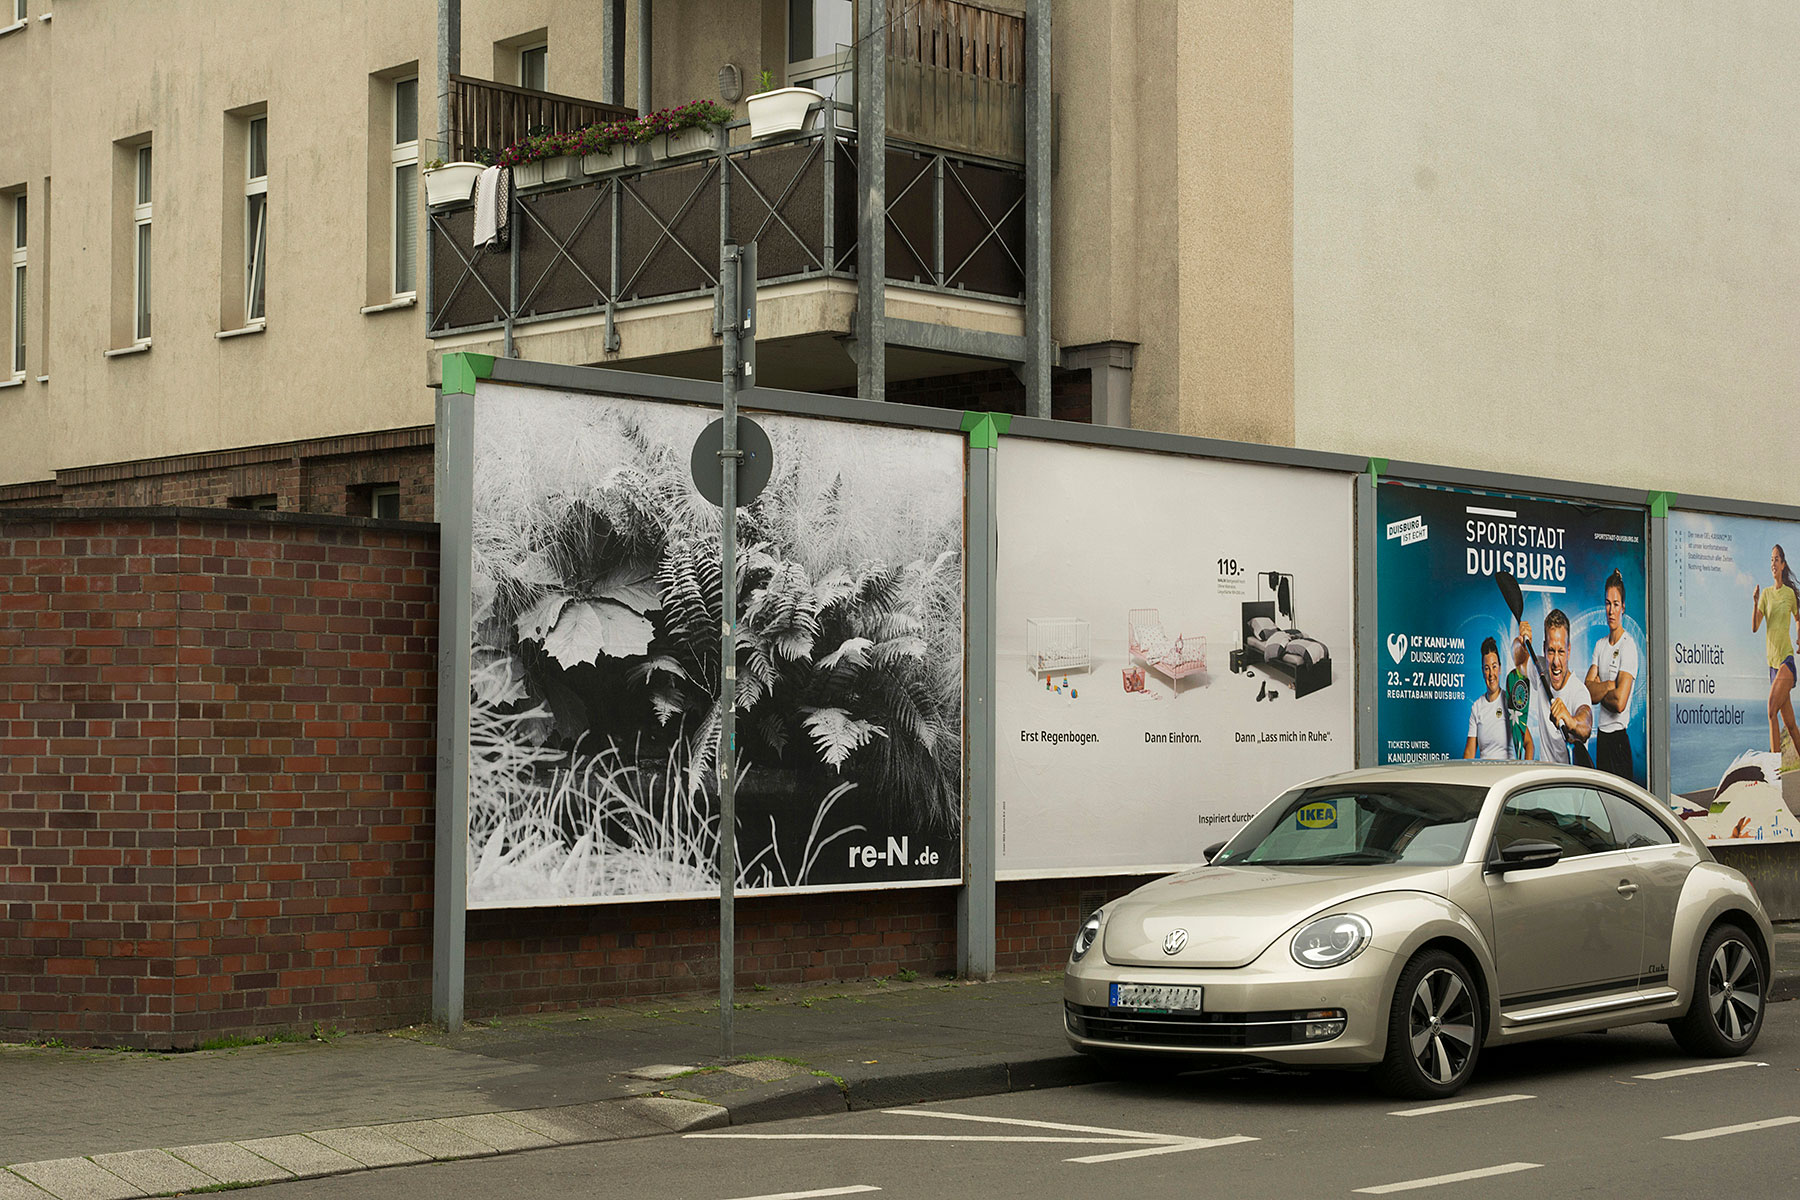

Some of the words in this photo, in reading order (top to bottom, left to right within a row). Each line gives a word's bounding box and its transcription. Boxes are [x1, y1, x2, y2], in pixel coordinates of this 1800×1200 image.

[1389, 519, 1419, 536] DUISBURG
[1466, 520, 1565, 550] SPORTSTADT
[1217, 558, 1245, 576] 119.-
[1466, 547, 1567, 582] DUISBURG
[1410, 635, 1423, 648] ICF
[1424, 636, 1465, 650] KANU-WM
[1410, 651, 1446, 664] DUISBURG
[1447, 652, 1465, 665] 2023
[1674, 642, 1725, 666] Stabilität
[1387, 671, 1403, 686] 23.
[1412, 672, 1427, 687] 27.
[1428, 672, 1465, 688] AUGUST
[1675, 678, 1696, 694] war
[1698, 674, 1716, 695] nie
[1387, 689, 1433, 700] REGATTABAHN
[1434, 690, 1466, 701] DUISBURG
[1675, 703, 1746, 725] komfortabler
[1020, 730, 1039, 742] Erst
[1041, 730, 1100, 746] Regenbogen.
[1144, 732, 1168, 743] Dann
[1169, 731, 1202, 743] Einhorn.
[1235, 731, 1256, 743] Dann
[1279, 730, 1298, 742] mich
[1299, 730, 1307, 742] in
[1387, 740, 1410, 749] TICKETS
[1387, 752, 1450, 763] KANUDUISBURGDE
[1198, 814, 1231, 826] Inspiriert
[1299, 808, 1334, 821] IKEA
[848, 836, 909, 868] re-N
